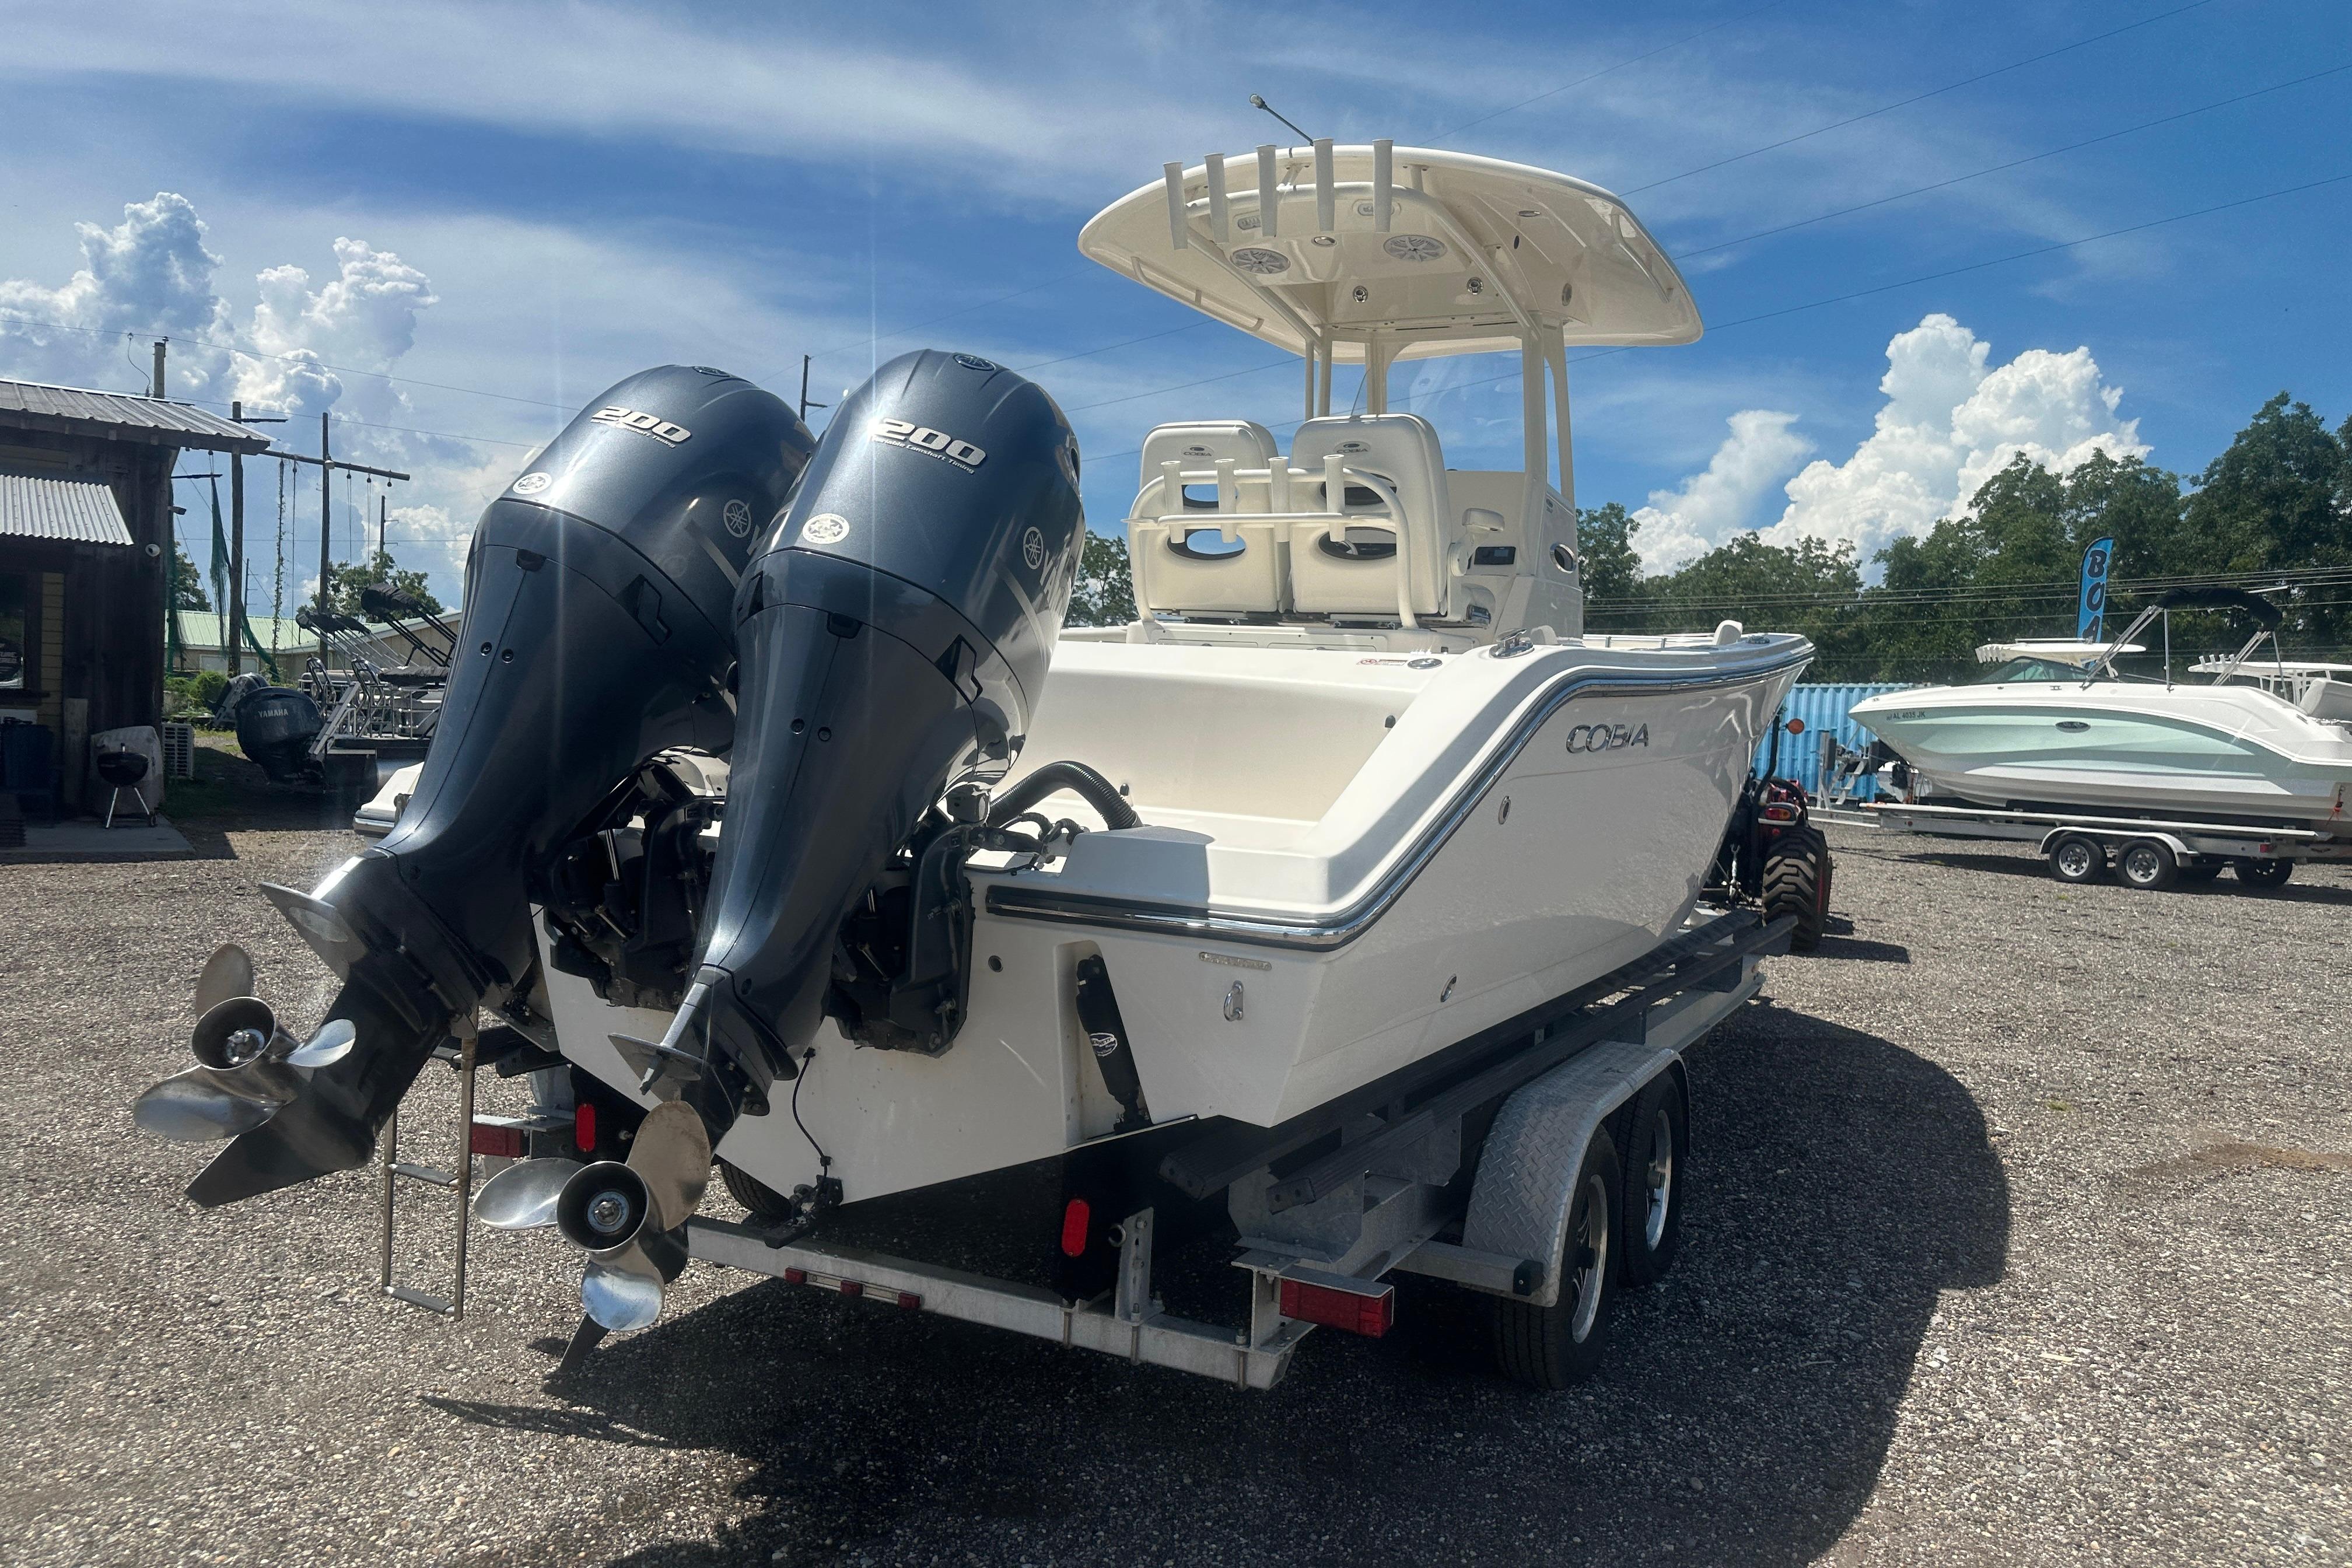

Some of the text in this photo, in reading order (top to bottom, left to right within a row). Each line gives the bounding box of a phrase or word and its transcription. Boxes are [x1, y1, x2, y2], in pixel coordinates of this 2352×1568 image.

[592, 406, 691, 442] 200
[872, 418, 987, 466] 200
[906, 444, 947, 462] Camshaft
[948, 458, 975, 474] Timing
[2082, 550, 2107, 643] BOA
[257, 708, 289, 718] YAMAHA
[1566, 723, 1649, 754] COBIA
